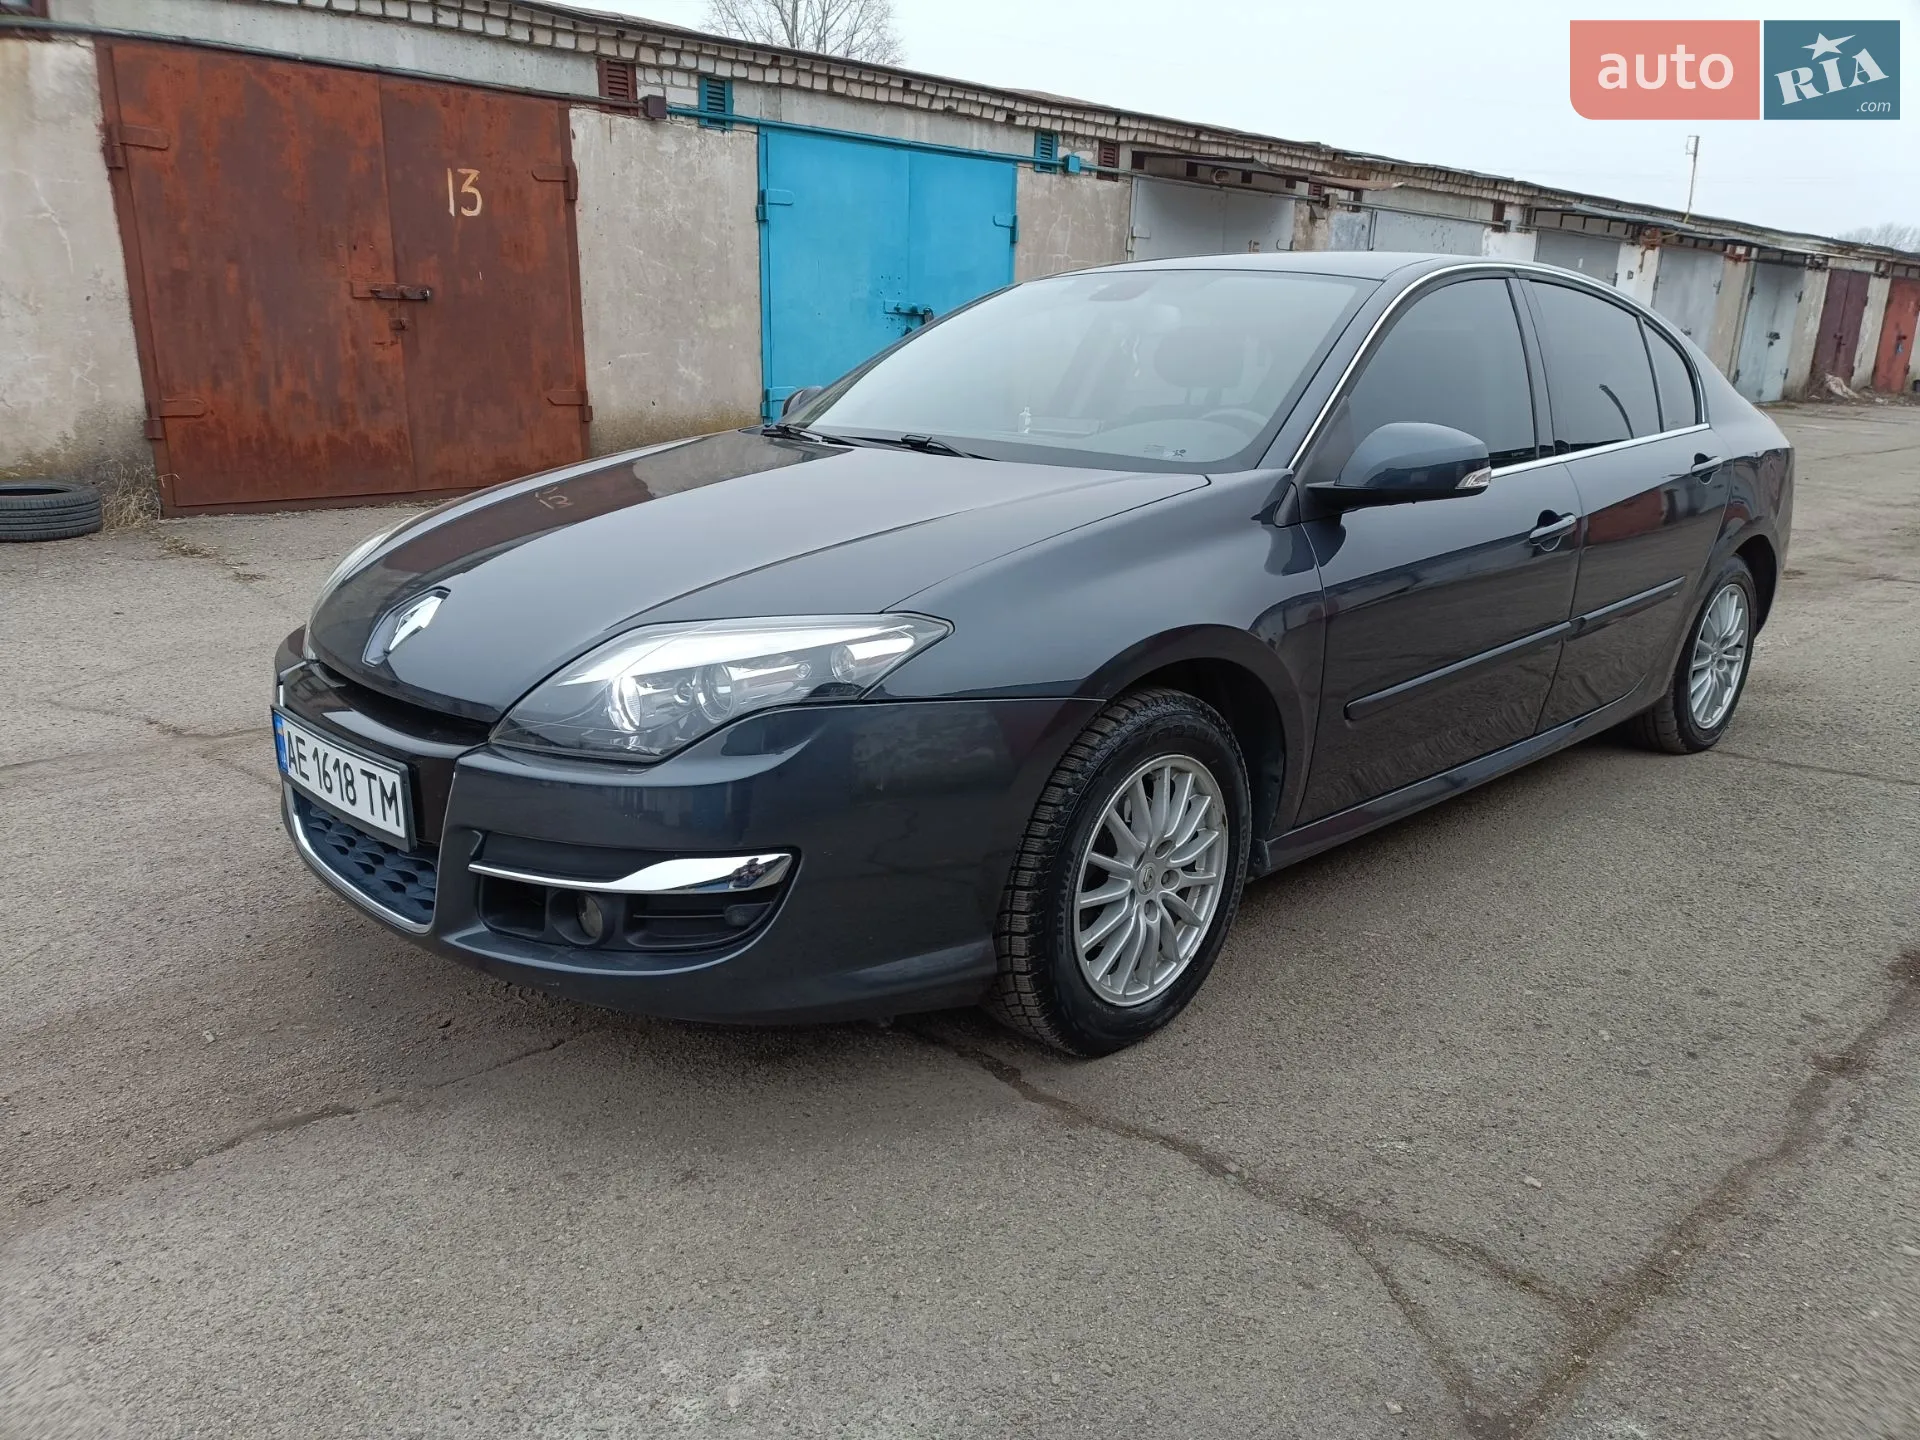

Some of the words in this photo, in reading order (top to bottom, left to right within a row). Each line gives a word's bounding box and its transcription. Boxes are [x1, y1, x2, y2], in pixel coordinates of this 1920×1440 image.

[447, 167, 482, 216] 13
[287, 730, 310, 782] AE
[312, 747, 357, 806] 1618
[360, 768, 401, 827] TM
